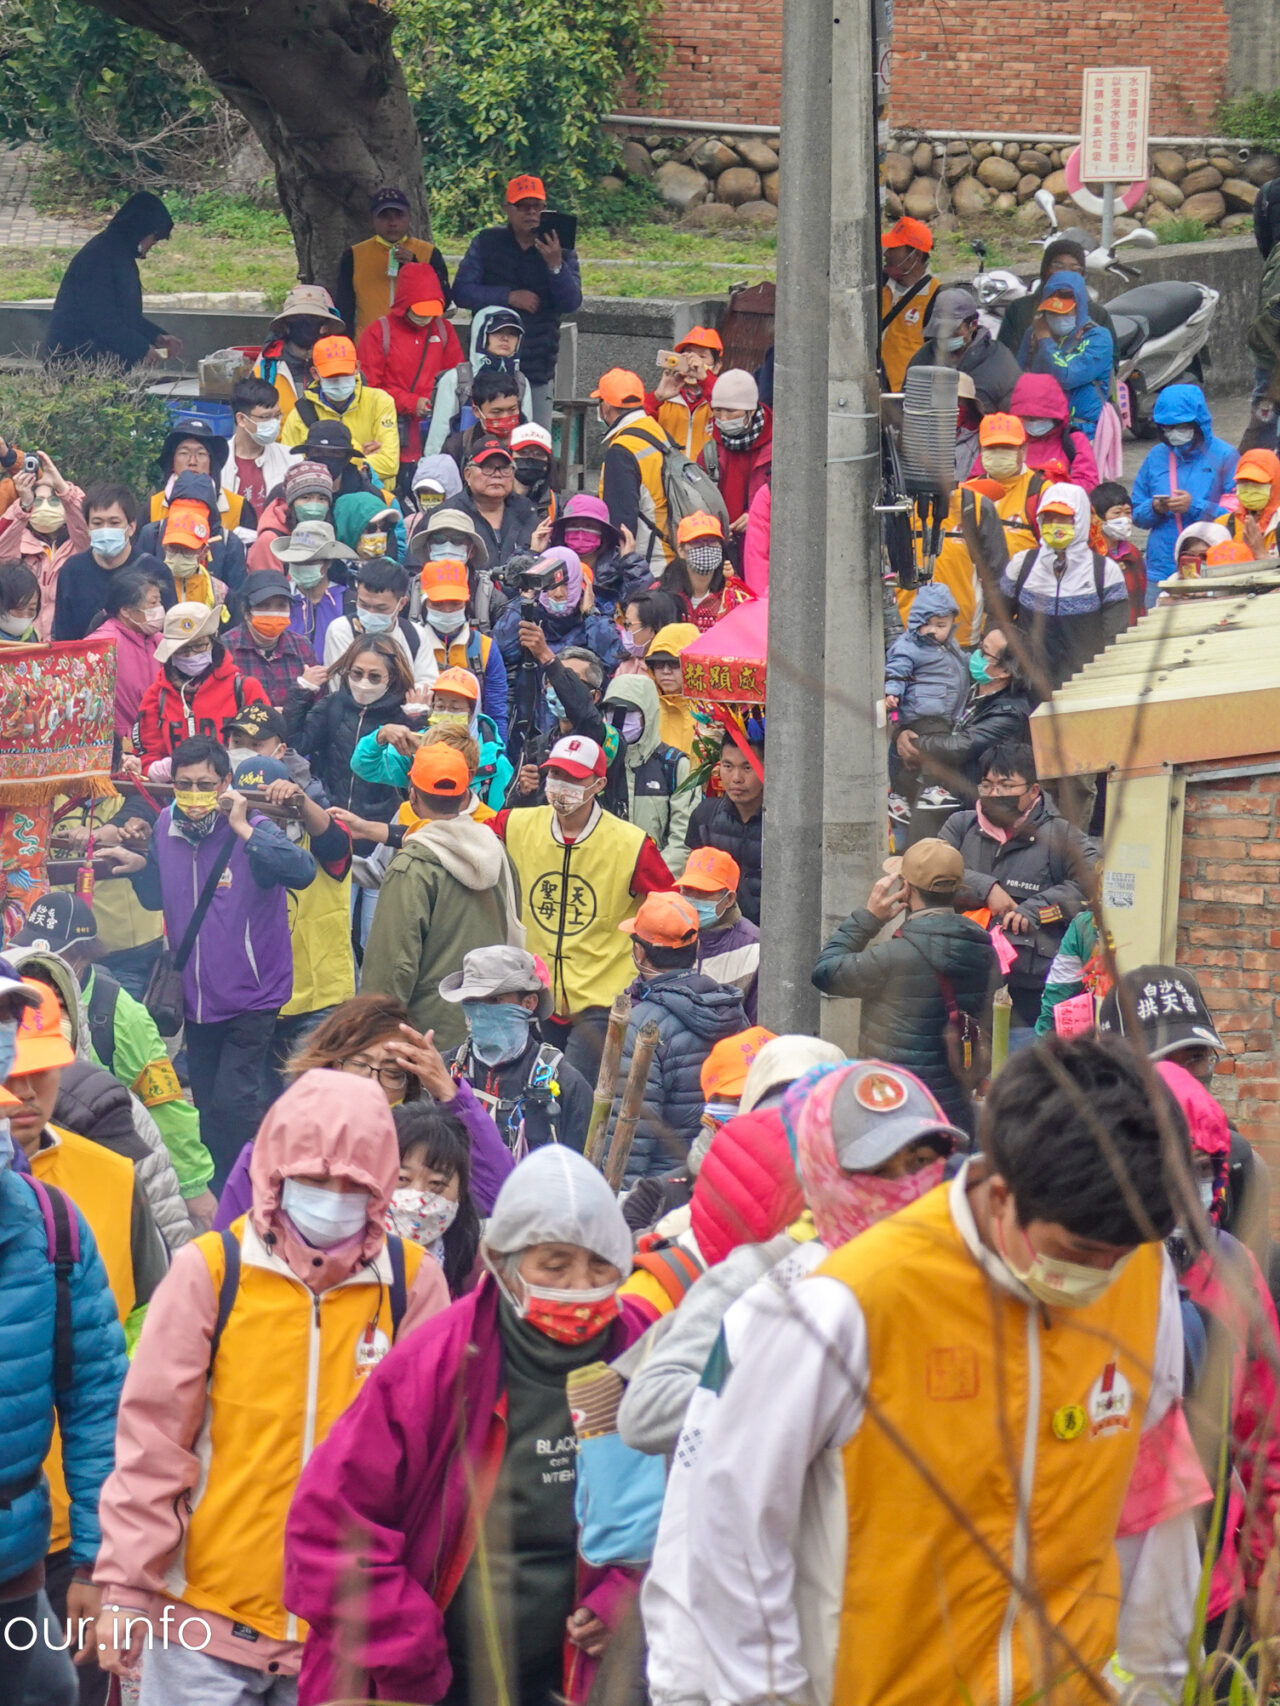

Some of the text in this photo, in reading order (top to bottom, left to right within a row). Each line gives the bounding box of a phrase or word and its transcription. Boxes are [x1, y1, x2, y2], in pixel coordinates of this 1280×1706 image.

[684, 662, 767, 695] 威顯赫
[537, 879, 560, 921] 聖母
[566, 882, 587, 926] 天上
[1143, 979, 1188, 998] 白沙屯
[1137, 993, 1198, 1020] 拱天宮
